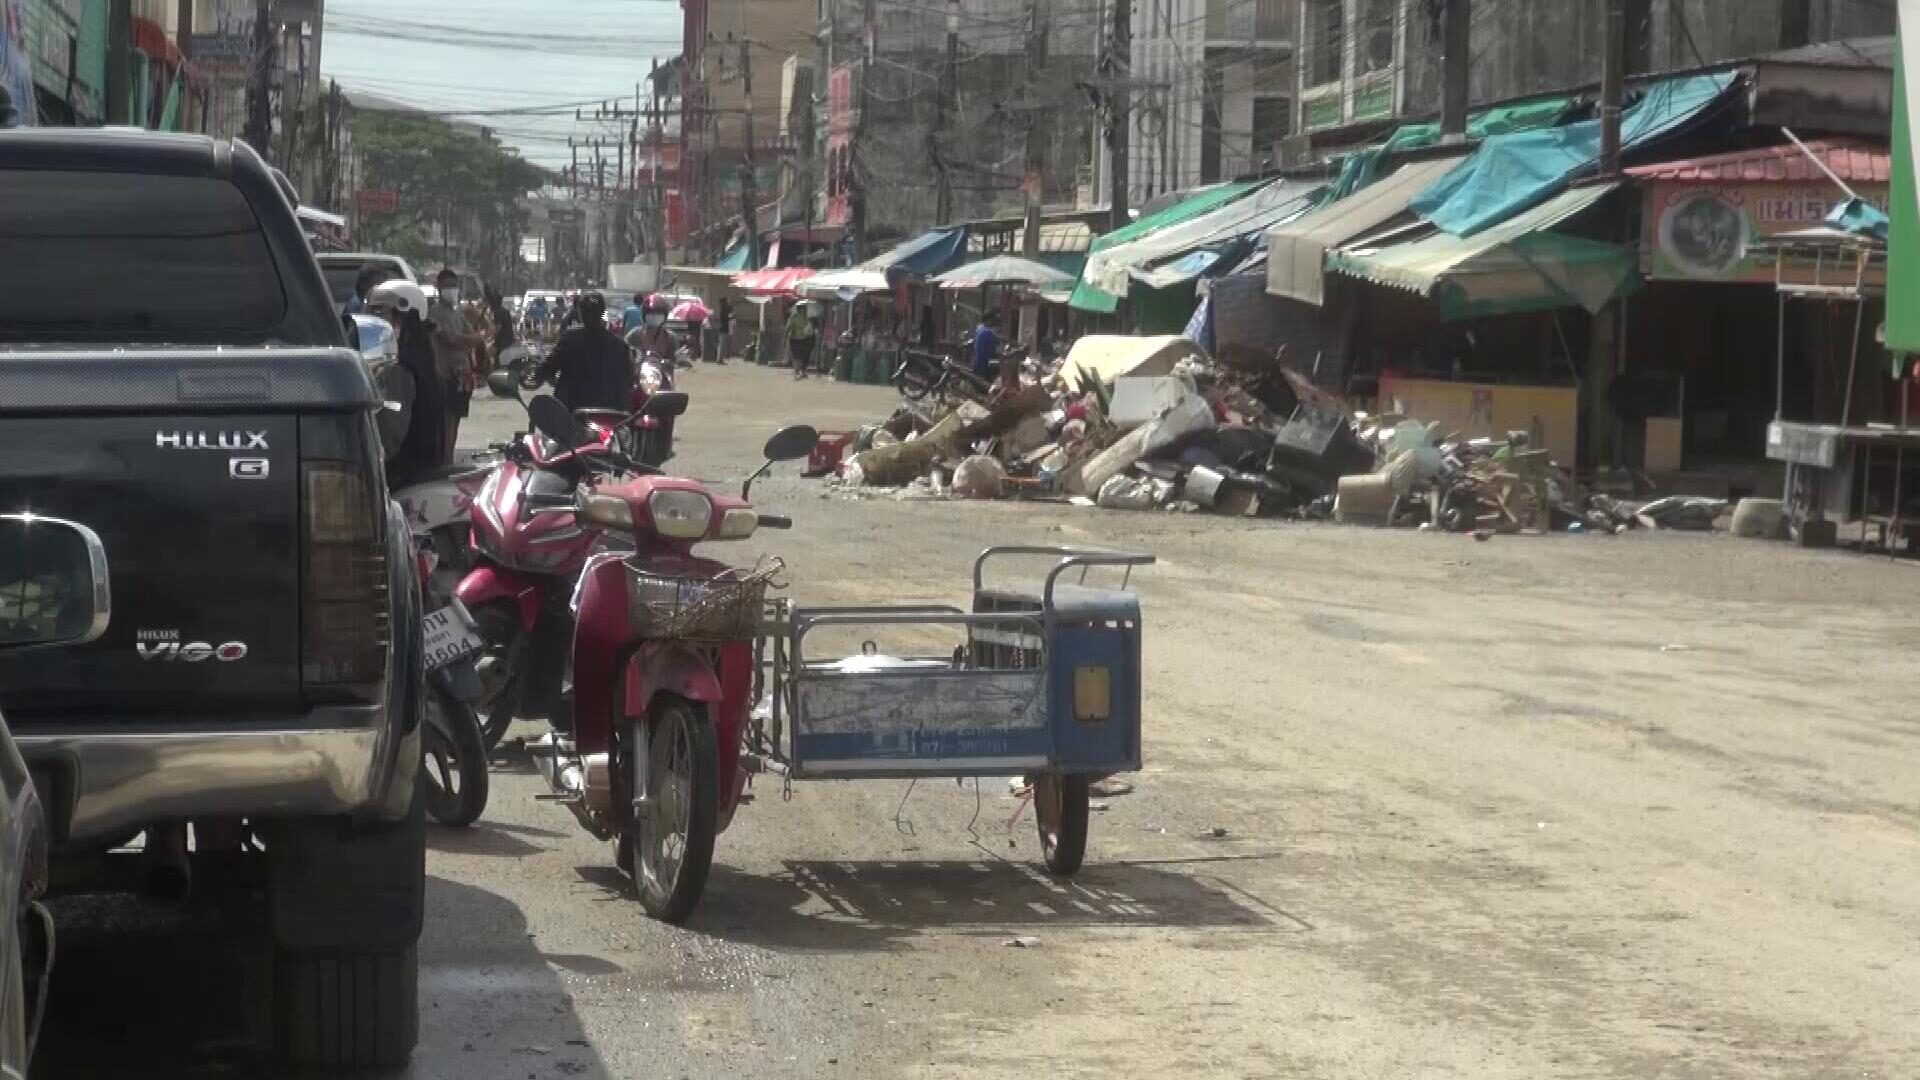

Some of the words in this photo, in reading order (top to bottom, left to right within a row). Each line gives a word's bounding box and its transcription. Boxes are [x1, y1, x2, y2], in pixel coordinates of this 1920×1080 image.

[156, 430, 269, 449] HILUX
[136, 630, 178, 640] HILUX
[135, 641, 248, 662] VIGO
